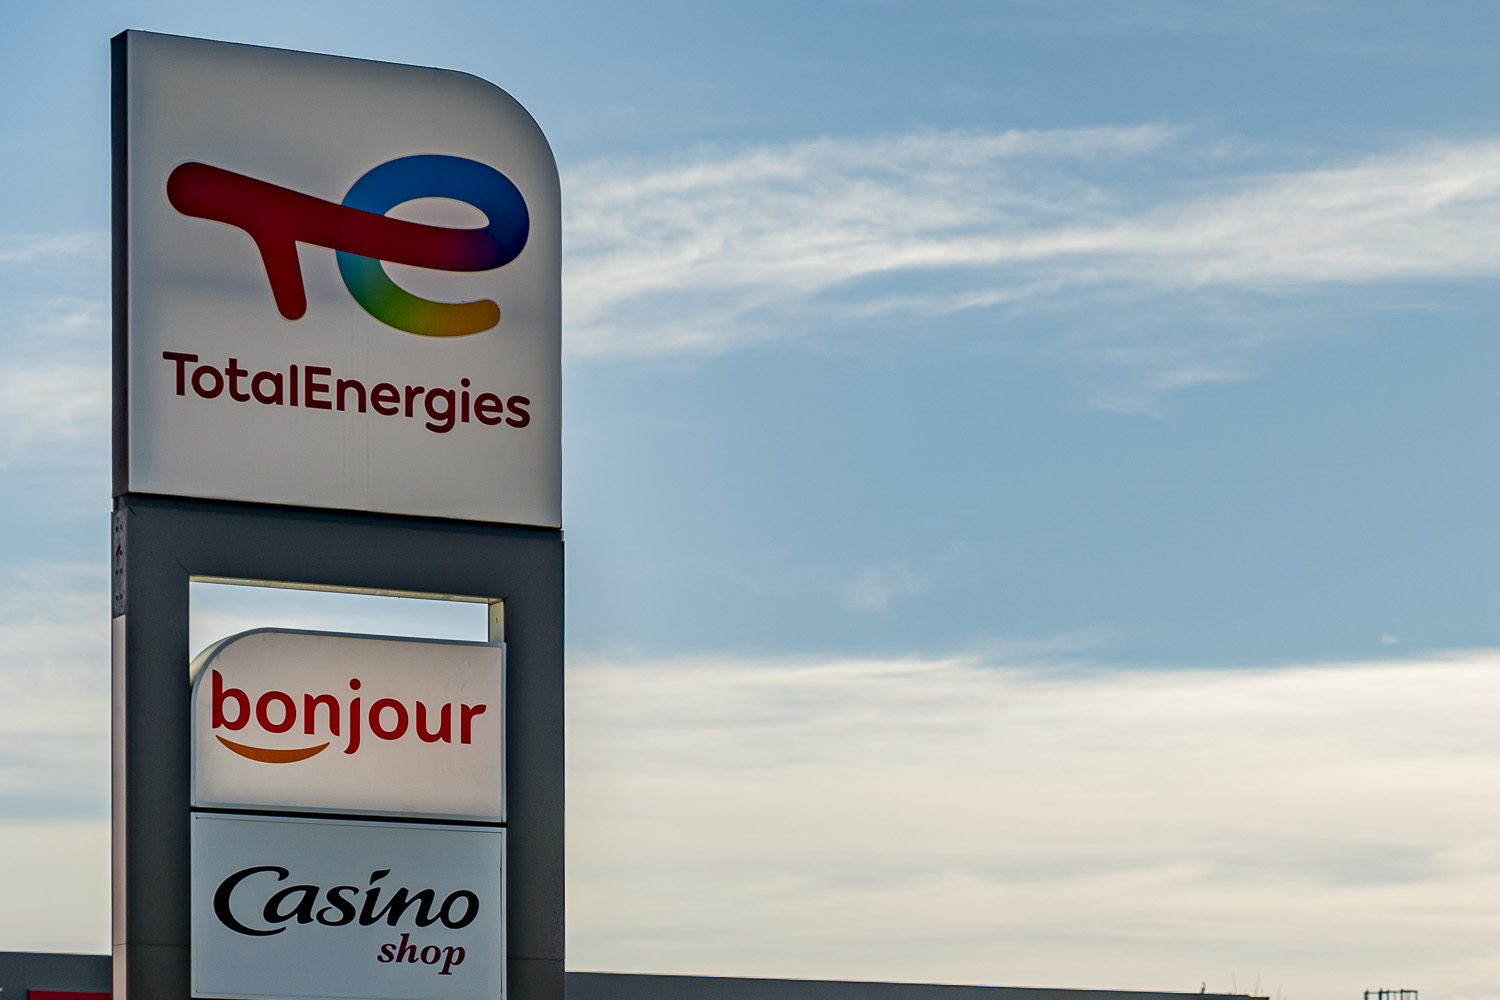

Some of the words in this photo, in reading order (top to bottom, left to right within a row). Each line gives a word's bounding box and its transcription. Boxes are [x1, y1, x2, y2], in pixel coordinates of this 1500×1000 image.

[162, 350, 532, 434] TotalEnergies
[211, 668, 487, 756] bonjour
[213, 865, 480, 937] Casino
[376, 932, 467, 976] shop
